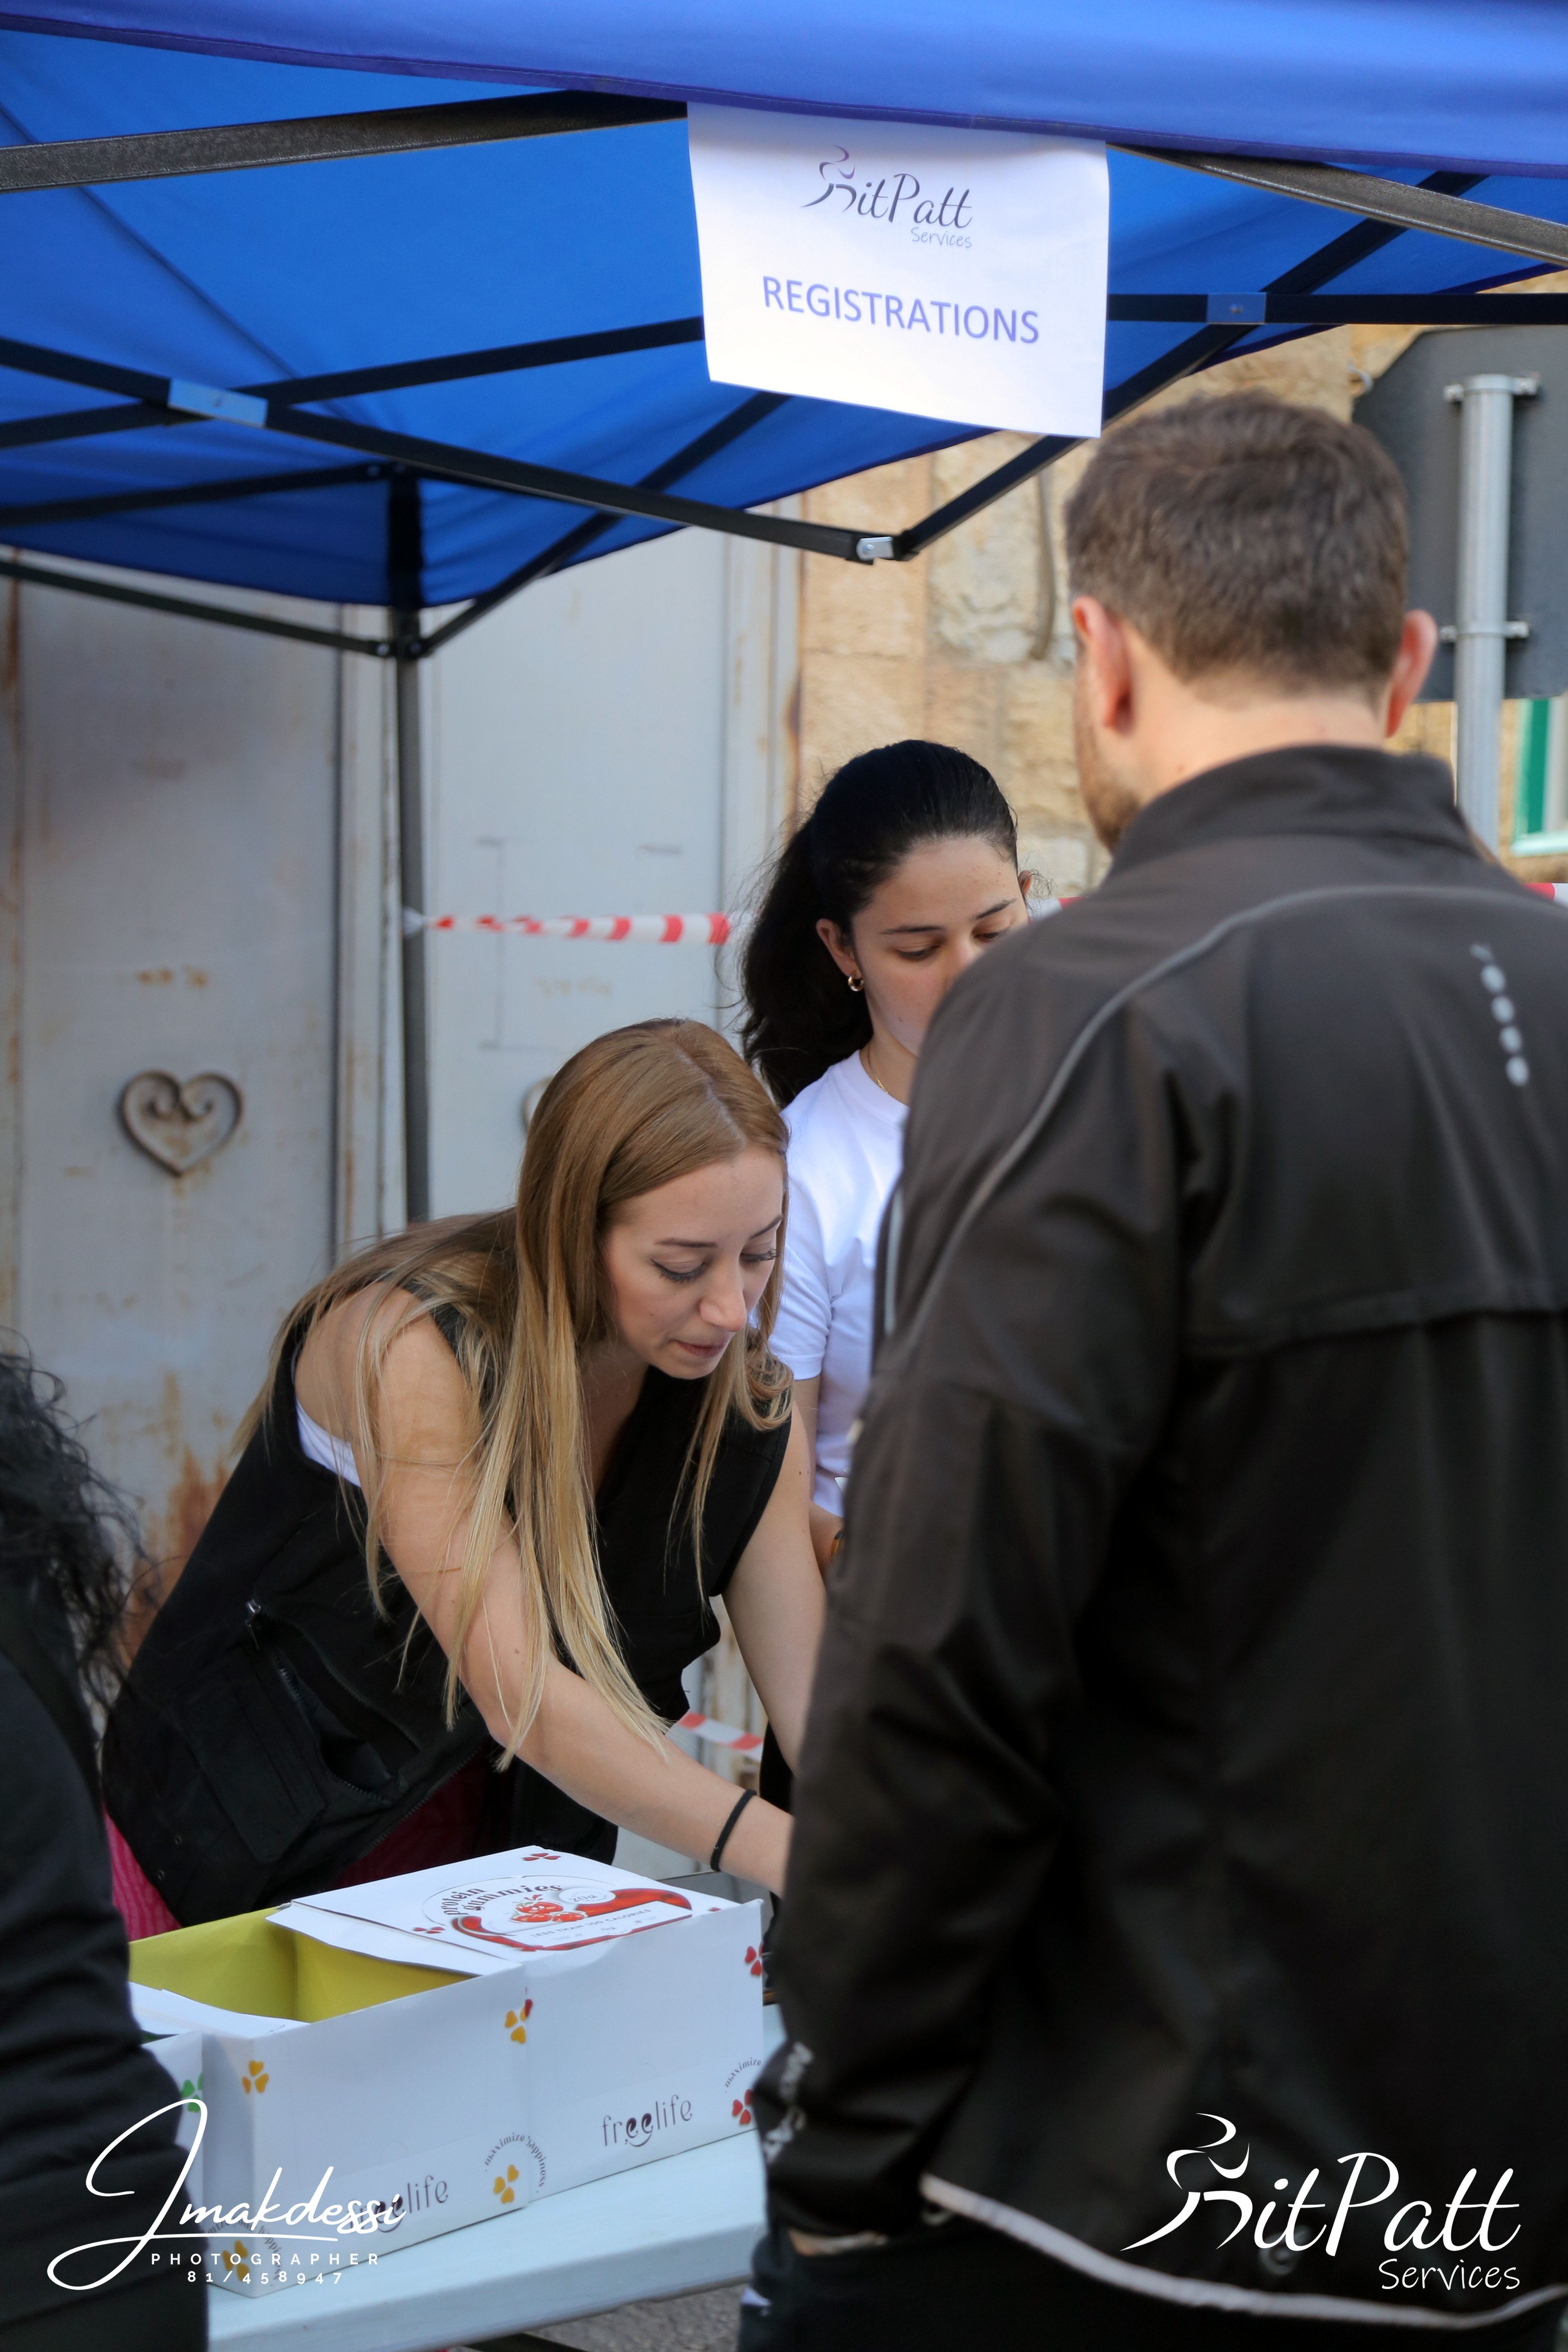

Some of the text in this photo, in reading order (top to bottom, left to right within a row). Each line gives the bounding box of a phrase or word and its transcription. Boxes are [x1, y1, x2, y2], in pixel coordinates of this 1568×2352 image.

[911, 227, 972, 248] Services
[763, 275, 1040, 344] REGISTRATIONS
[441, 1888, 487, 1915] protein
[461, 1885, 563, 1911] gummies
[605, 1909, 652, 1922] CALORIES
[725, 2057, 762, 2088] maximize
[602, 2095, 693, 2147] freelife
[485, 2132, 525, 2166] maximize
